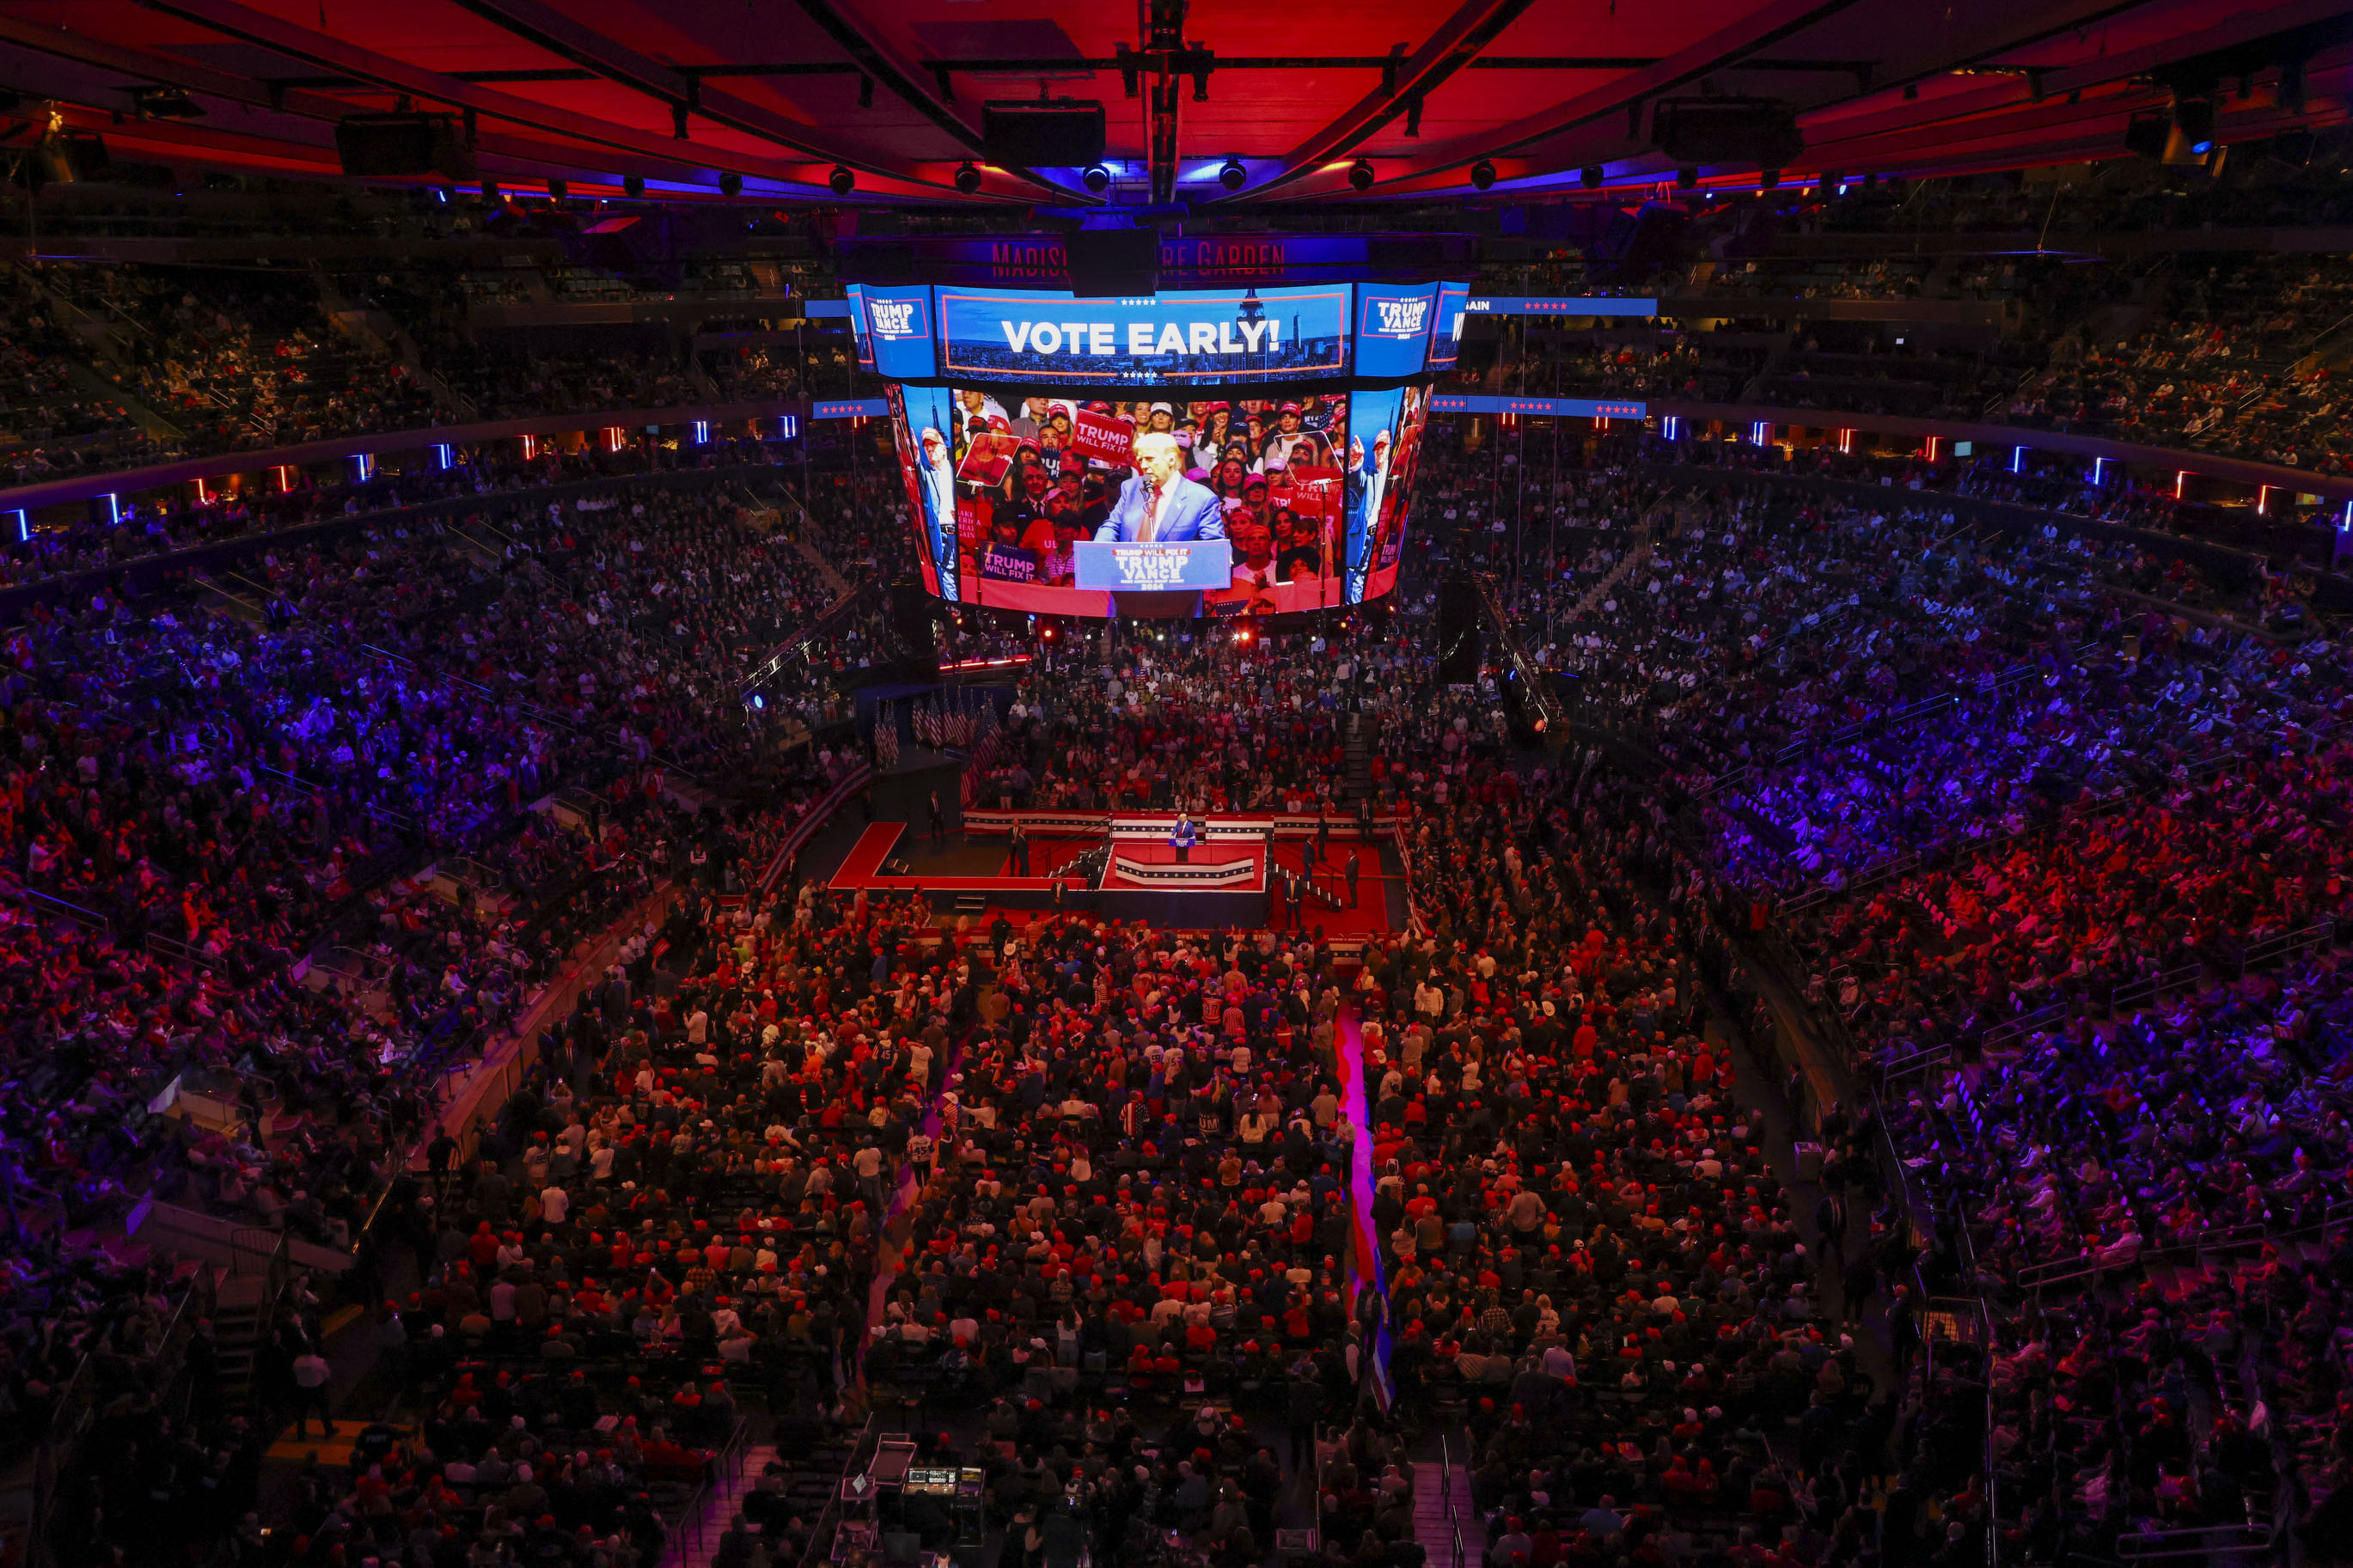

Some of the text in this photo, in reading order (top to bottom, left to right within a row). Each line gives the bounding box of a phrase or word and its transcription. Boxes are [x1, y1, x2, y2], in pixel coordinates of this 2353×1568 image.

[871, 303, 914, 319] TRUMP
[1378, 302, 1427, 317] TRUMP
[1466, 302, 1490, 310] AIN
[1384, 315, 1421, 328] VANCE
[1001, 320, 1280, 355] VOTE EARLY!
[1077, 423, 1128, 446] TRUMP
[1076, 434, 1128, 455] WILL FIX IT
[1297, 491, 1321, 502] WILL
[984, 552, 1036, 573] TRUMP
[1115, 556, 1189, 570] TRUMP
[985, 564, 1007, 577] WILL
[1009, 570, 1024, 580] FIX
[1124, 568, 1181, 580] VANCE
